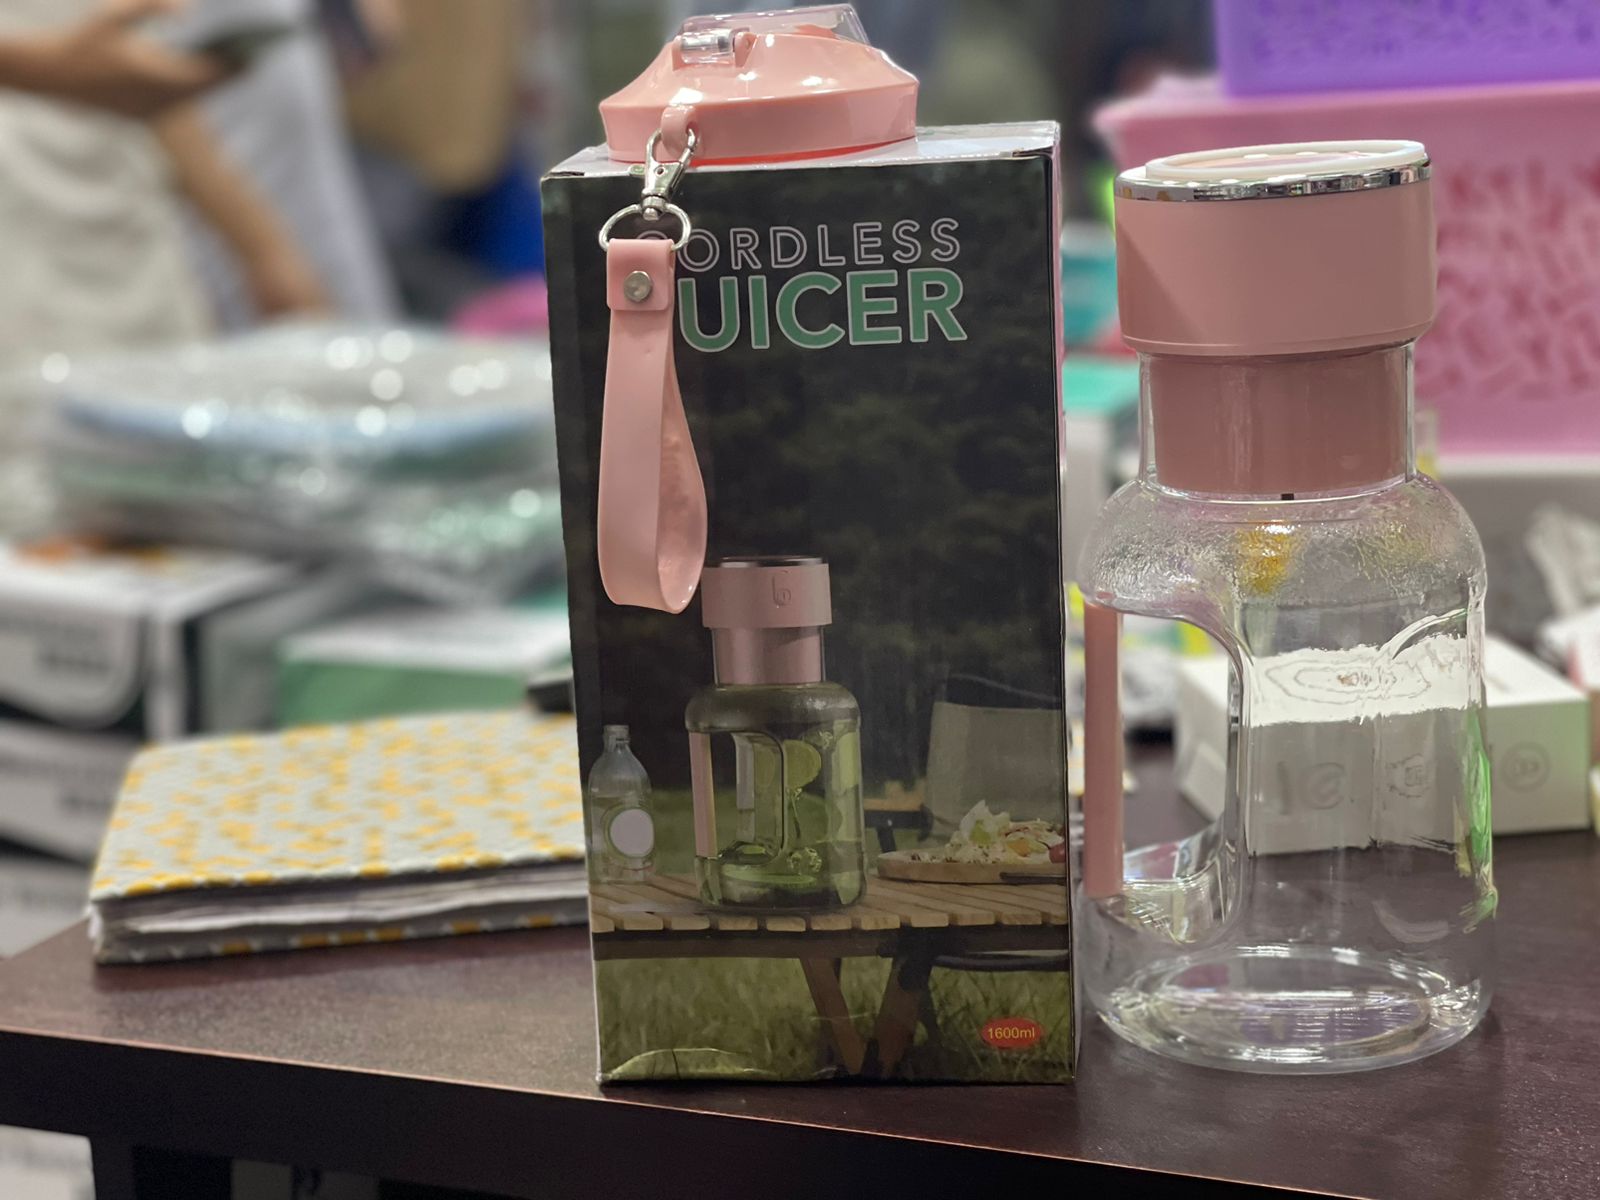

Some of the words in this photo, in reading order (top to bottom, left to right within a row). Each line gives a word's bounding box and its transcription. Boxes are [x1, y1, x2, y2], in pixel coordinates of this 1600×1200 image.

[637, 217, 961, 272] ORDLESS
[677, 267, 968, 352] UICER
[988, 1026, 1036, 1040] 1600ml
